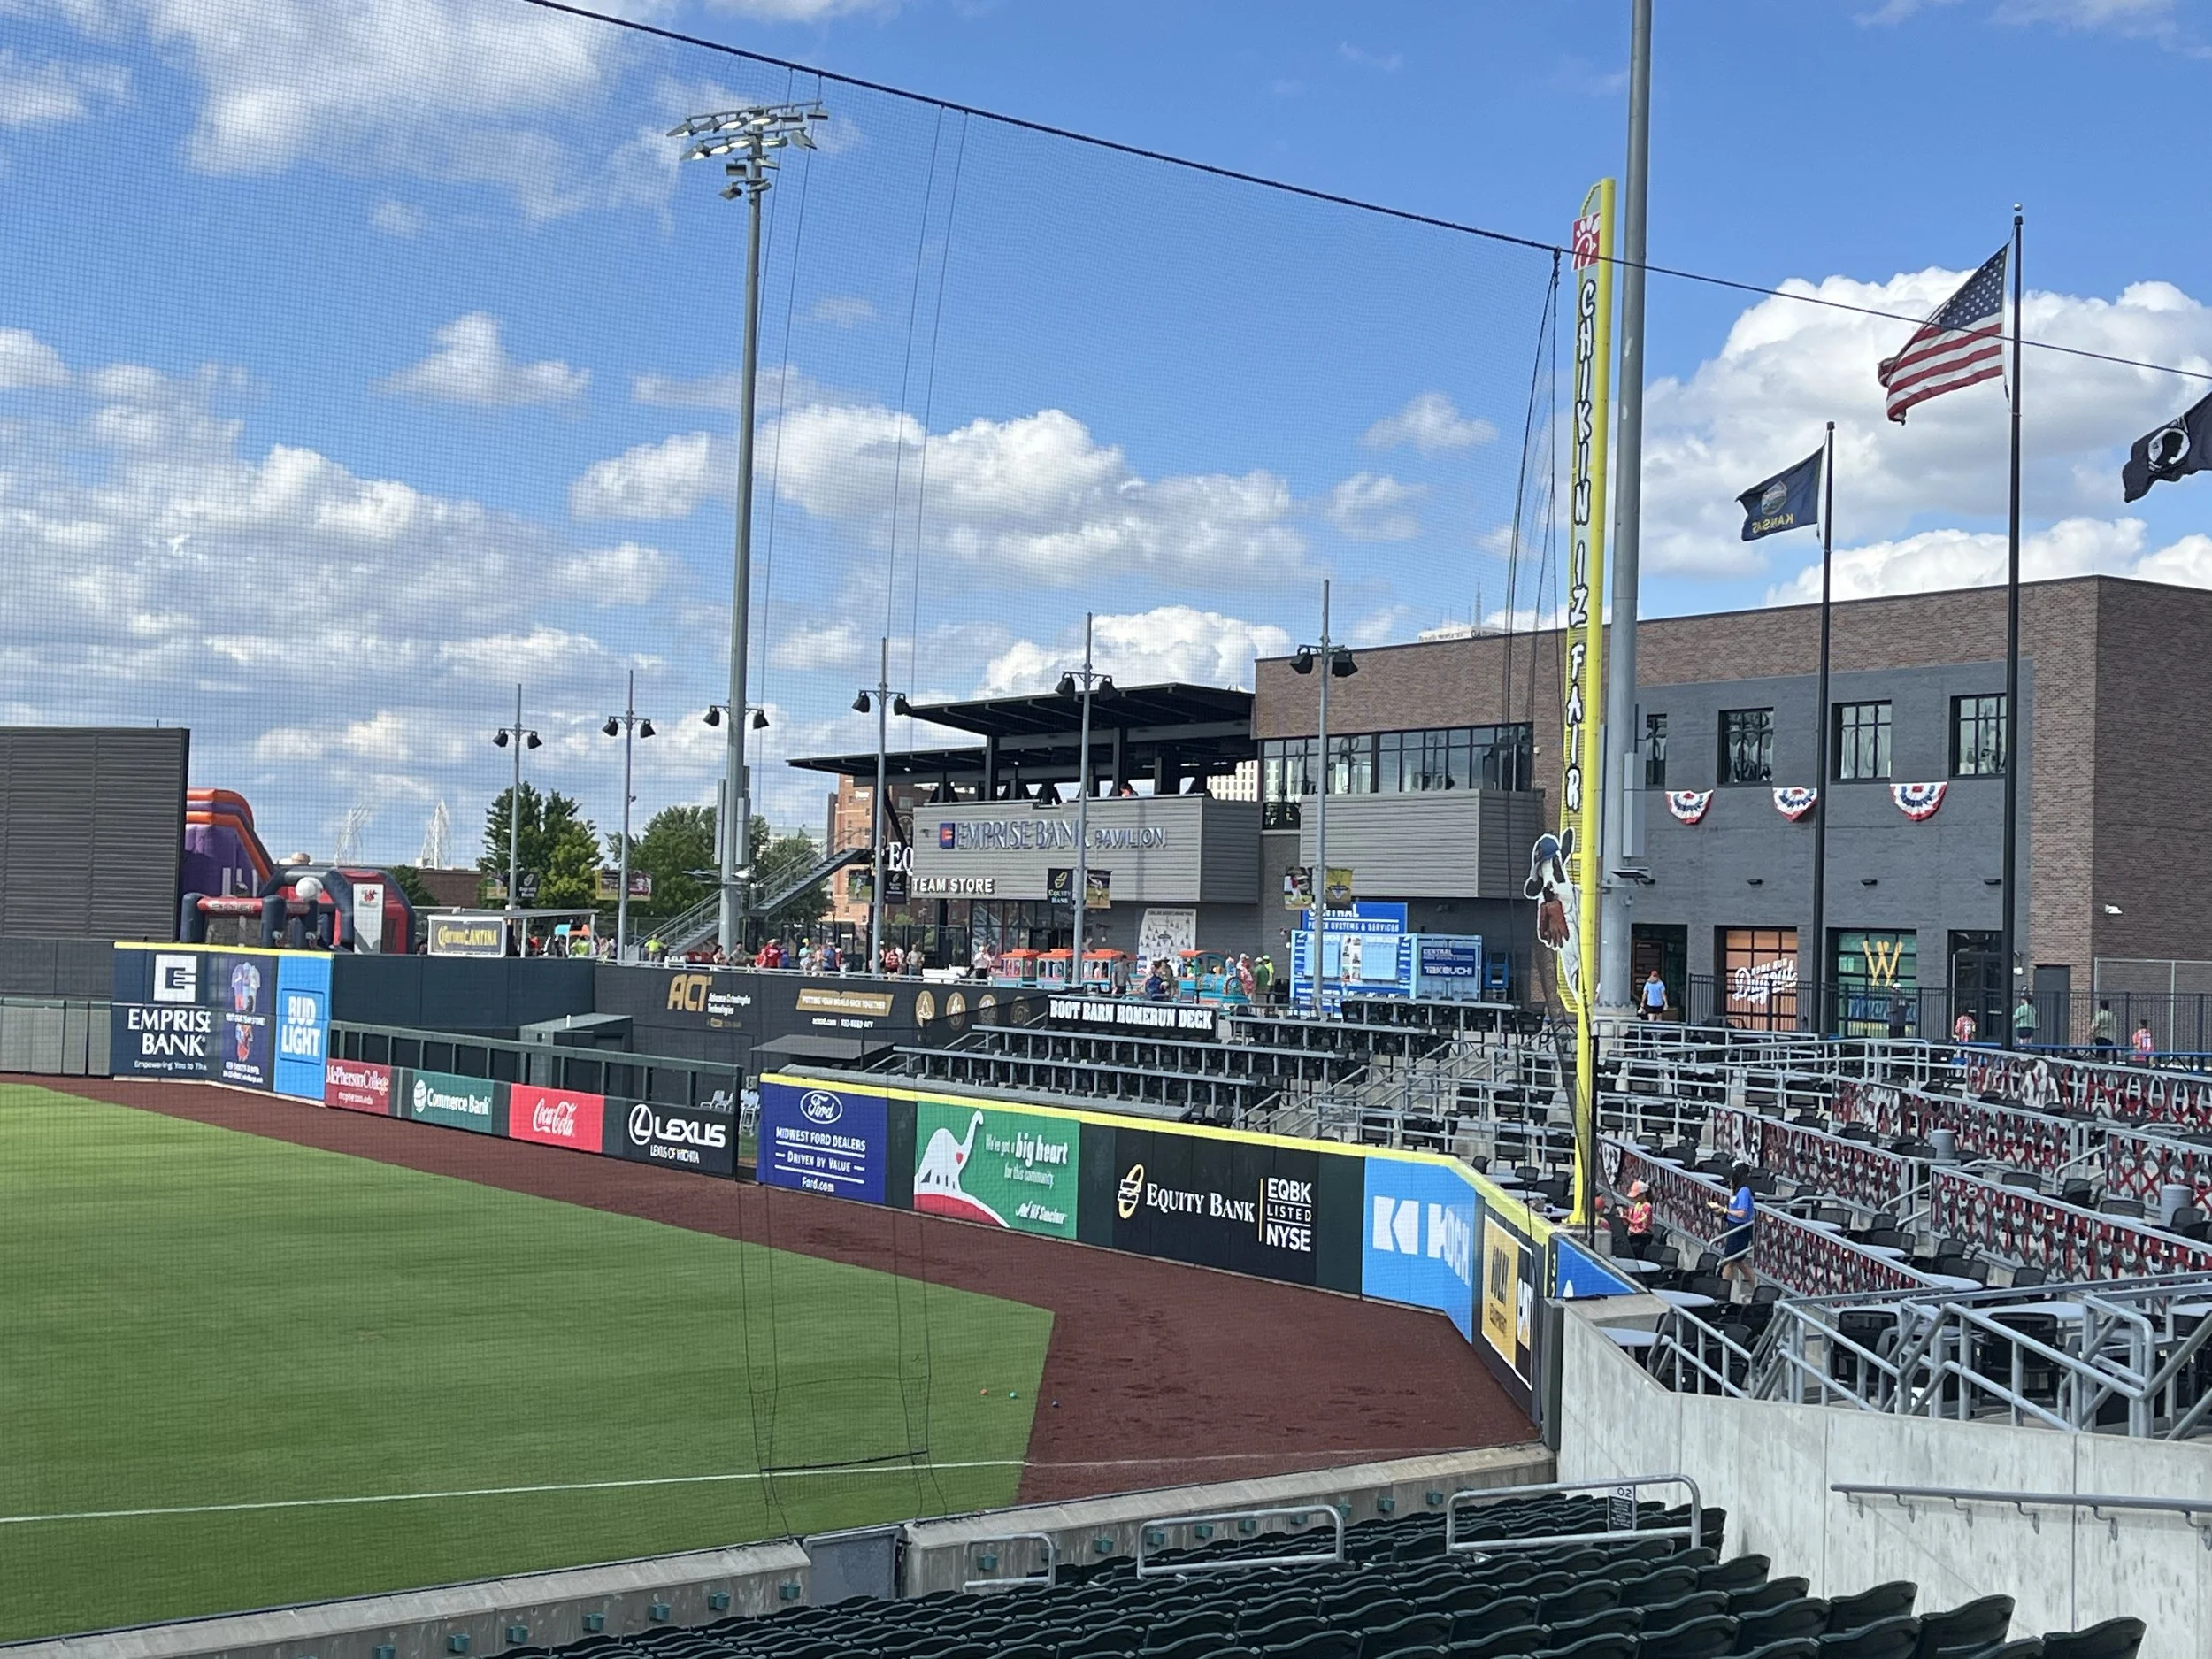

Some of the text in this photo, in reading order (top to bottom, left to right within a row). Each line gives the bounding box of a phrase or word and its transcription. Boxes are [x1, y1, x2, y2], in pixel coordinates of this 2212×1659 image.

[1565, 279, 1596, 812] CHIKIN IZ FAIR
[956, 821, 1033, 849] EMPRISE
[1094, 827, 1167, 849] PAVILION
[912, 878, 946, 892] TEAM
[950, 878, 993, 893] STORE
[464, 929, 497, 946] CANTINA
[668, 974, 713, 1013] ACT
[127, 1008, 211, 1033] EMPRISE
[288, 995, 316, 1026] BUD
[1049, 1000, 1212, 1030] BOOT BARN HOMERUN DECK
[281, 1025, 320, 1056] LIGHT
[426, 1088, 489, 1115] Commerce Bank
[807, 1094, 834, 1119] Ford
[655, 1116, 726, 1148] LEXUS
[776, 1126, 866, 1152] MIDWEST FORD DEALERS
[650, 1144, 667, 1158] LEXUS
[668, 1147, 676, 1159] OF
[1015, 1132, 1034, 1167] big
[1035, 1134, 1068, 1165] heart
[802, 1176, 834, 1193] Ford.com
[1267, 1177, 1312, 1204] EQBK
[1146, 1183, 1255, 1223] EQUITY BANK
[1267, 1204, 1311, 1223] LISTED
[1266, 1224, 1311, 1252] NYSE
